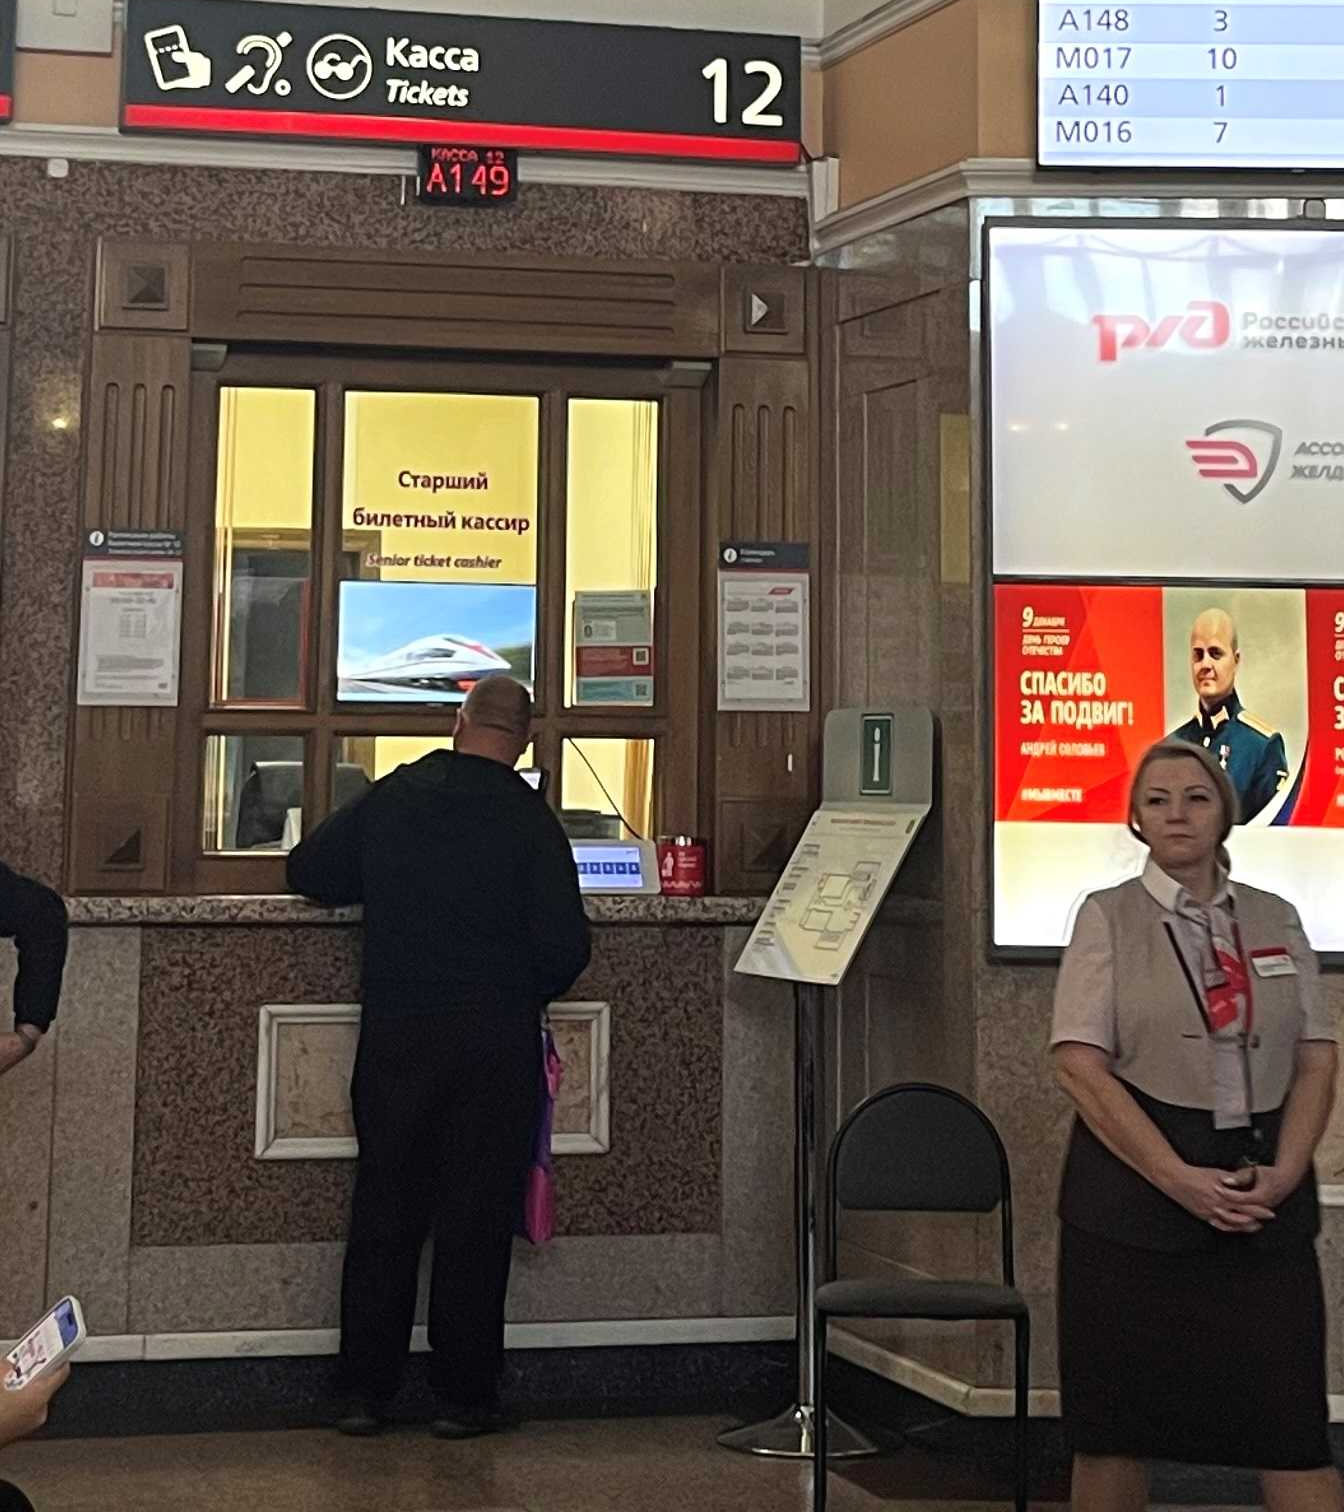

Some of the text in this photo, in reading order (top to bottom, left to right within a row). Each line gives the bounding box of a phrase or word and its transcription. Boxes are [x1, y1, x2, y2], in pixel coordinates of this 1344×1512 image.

[1214, 9, 1228, 32] 3
[386, 37, 479, 73] Касса
[1207, 47, 1237, 70] 10
[386, 79, 468, 108] Tickets
[702, 57, 784, 127] 12
[1217, 85, 1226, 107] 1
[1214, 122, 1227, 143] 7
[398, 470, 488, 493] Старший
[353, 507, 530, 535] билетный кассир
[367, 553, 502, 568] Senior ticket cashier
[1022, 606, 1034, 628] 9
[1020, 670, 1106, 696] СПАСИБО
[1020, 699, 1134, 730] ЗА ПОДВИГ!
